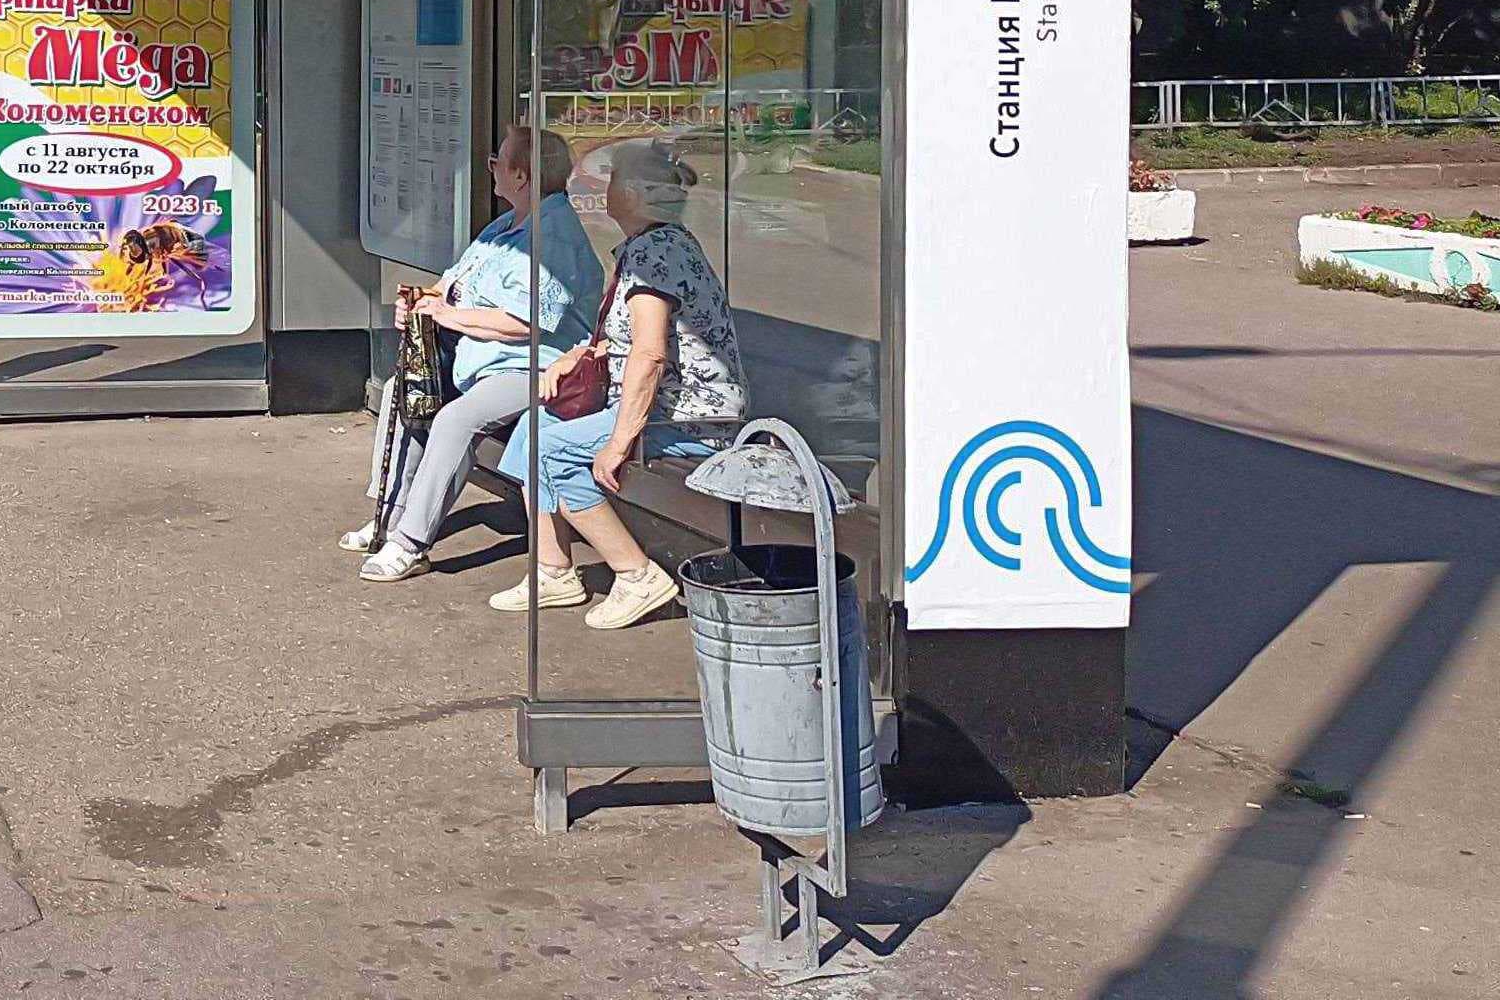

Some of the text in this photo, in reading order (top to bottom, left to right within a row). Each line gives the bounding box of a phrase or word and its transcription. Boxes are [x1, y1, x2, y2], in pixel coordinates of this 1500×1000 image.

[28, 25, 210, 96] Мёда
[989, 15, 1025, 158] Станция
[26, 143, 140, 160] с 11 августа
[18, 161, 155, 179] по 22 октября
[34, 200, 91, 213] автобус
[143, 196, 223, 216] 2023 г.
[10, 219, 106, 231] Коломенская
